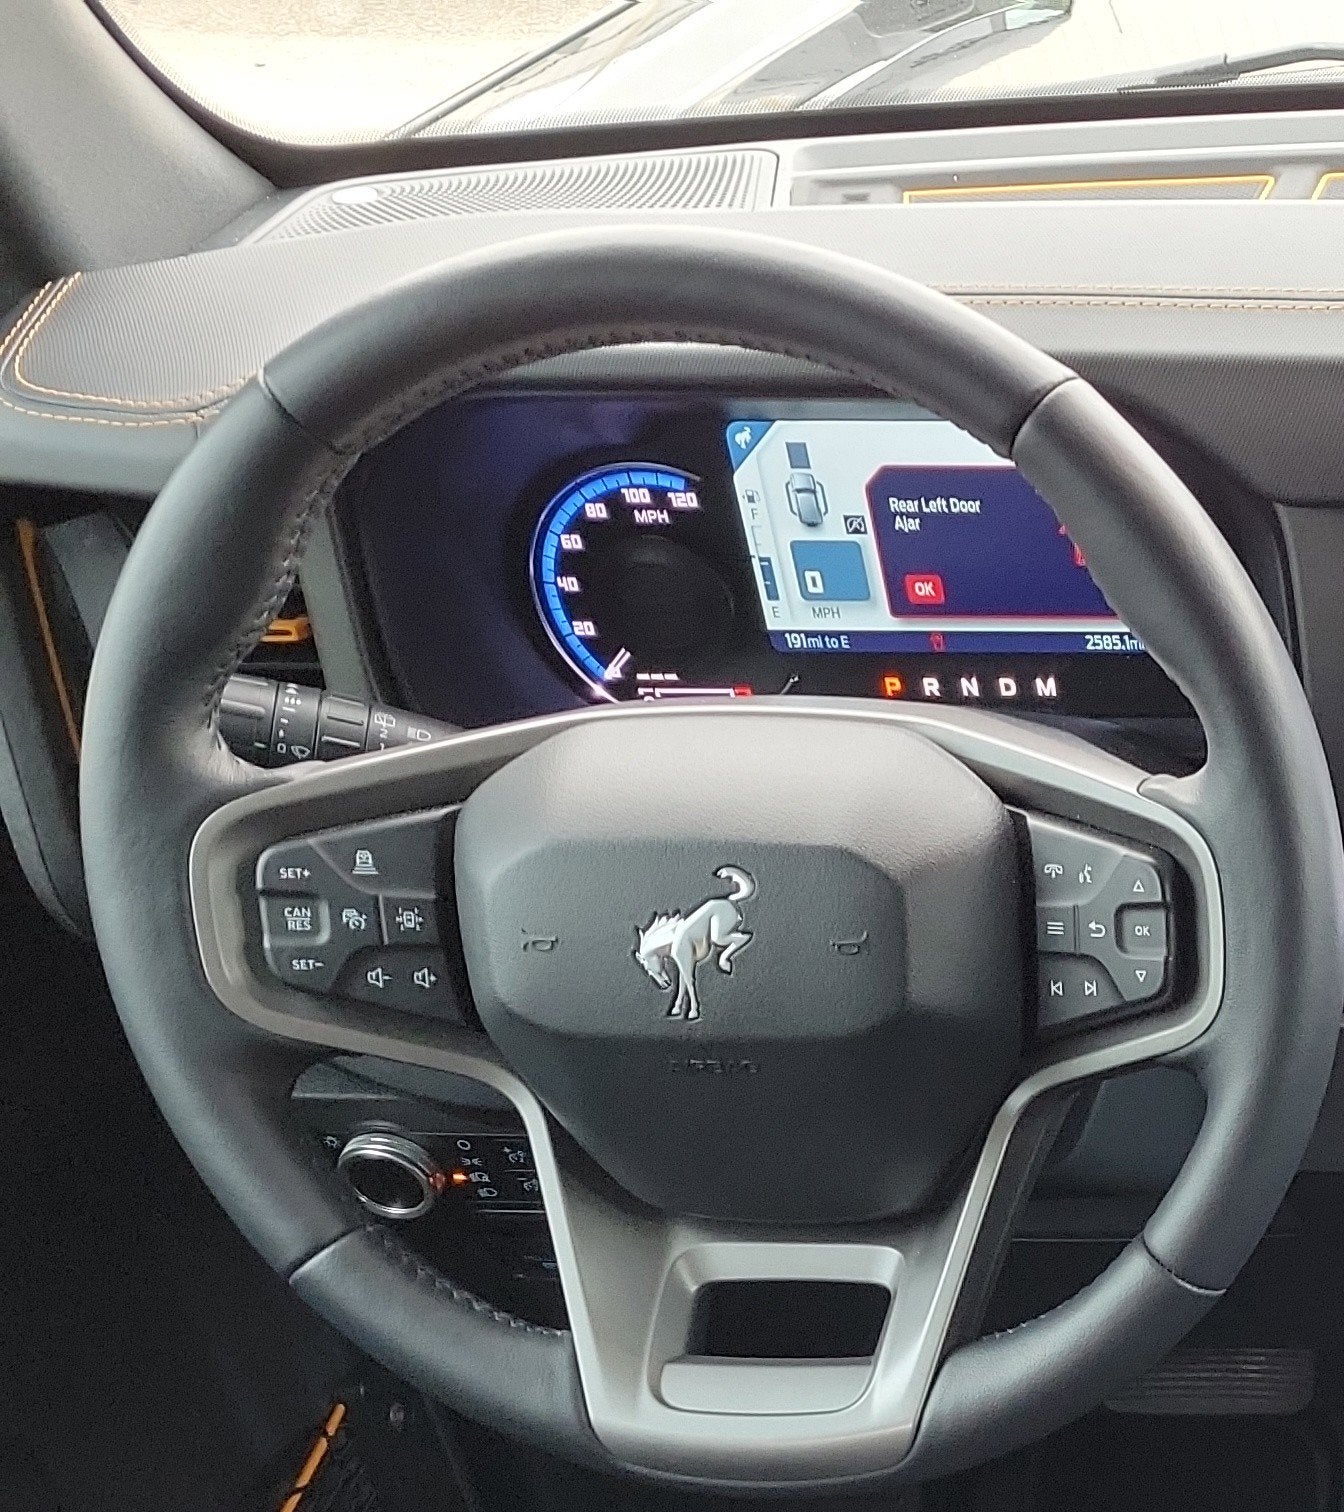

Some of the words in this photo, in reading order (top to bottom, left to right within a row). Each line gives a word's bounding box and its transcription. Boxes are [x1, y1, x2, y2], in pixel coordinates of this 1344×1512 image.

[620, 487, 651, 503] 100
[667, 491, 699, 508] 120
[584, 502, 608, 518] 80
[888, 497, 919, 513] Rear
[921, 497, 948, 513] Left
[950, 498, 982, 514] Door
[633, 508, 671, 524] MPH
[751, 508, 758, 520] F
[894, 516, 921, 533] Ajar
[560, 534, 583, 549] 60
[556, 576, 579, 592] 40
[914, 583, 936, 597] OK
[772, 606, 780, 618] E
[812, 606, 841, 619] MPH
[572, 620, 596, 636] 20
[824, 634, 837, 648] to
[840, 636, 850, 649] E
[884, 677, 902, 696] P
[922, 677, 941, 696] R
[960, 677, 980, 696] N
[998, 677, 1017, 696] D
[1036, 677, 1058, 697] M
[279, 868, 312, 880] SET+
[284, 907, 312, 917] CAN
[287, 920, 311, 931] RES
[1134, 926, 1150, 936] OK
